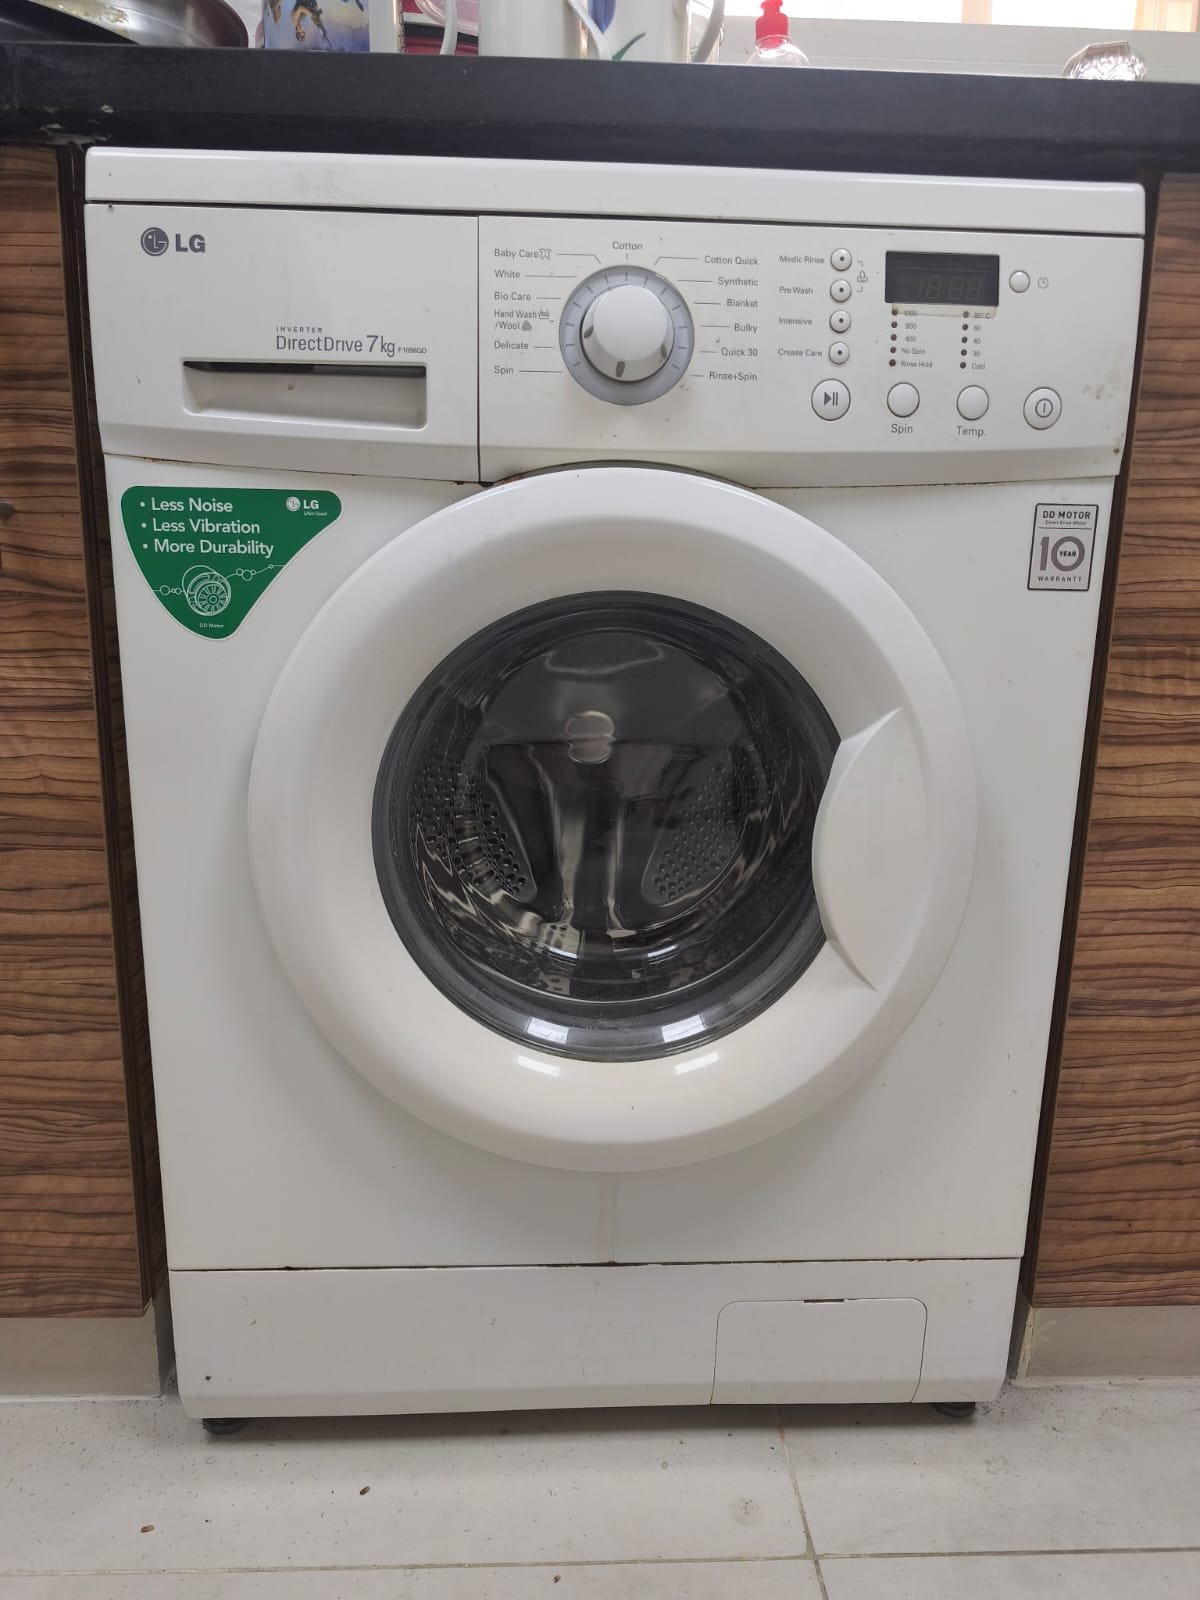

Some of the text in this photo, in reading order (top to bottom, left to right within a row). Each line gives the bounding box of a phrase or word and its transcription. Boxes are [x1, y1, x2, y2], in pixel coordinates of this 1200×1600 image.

[175, 233, 206, 253] LG
[612, 241, 643, 251] Cotton
[494, 248, 539, 259] Baby Care
[704, 255, 759, 266] Cotton Quick
[779, 255, 825, 264] Medic Rinse
[494, 269, 521, 279] White
[718, 276, 759, 287] Synthetic
[494, 291, 532, 301] Bio Care
[792, 287, 814, 295] Wash
[726, 298, 759, 308] Blanket
[494, 309, 537, 319] Hand Wash
[494, 320, 520, 331] /Wool
[778, 316, 813, 326] Intensive
[276, 326, 323, 334] INVERTER
[734, 323, 758, 334] Bulky
[494, 341, 529, 350] Delicate
[721, 347, 759, 357] Quick 30
[778, 348, 823, 357] Crease Care
[911, 347, 926, 356] Spin
[900, 360, 933, 369] Rinse Hold
[494, 366, 514, 376] Spin
[709, 371, 758, 383] Rinse+Spin
[890, 423, 913, 436] Spin
[956, 426, 987, 438] Temp.
[151, 497, 233, 513] Less Noise
[303, 499, 320, 510] LG
[1042, 510, 1091, 520] DD MOTOR
[152, 517, 260, 534] Less Vibration
[154, 538, 274, 558] More Durability
[1040, 536, 1086, 572] 10
[1038, 575, 1082, 583] WARRANTY
